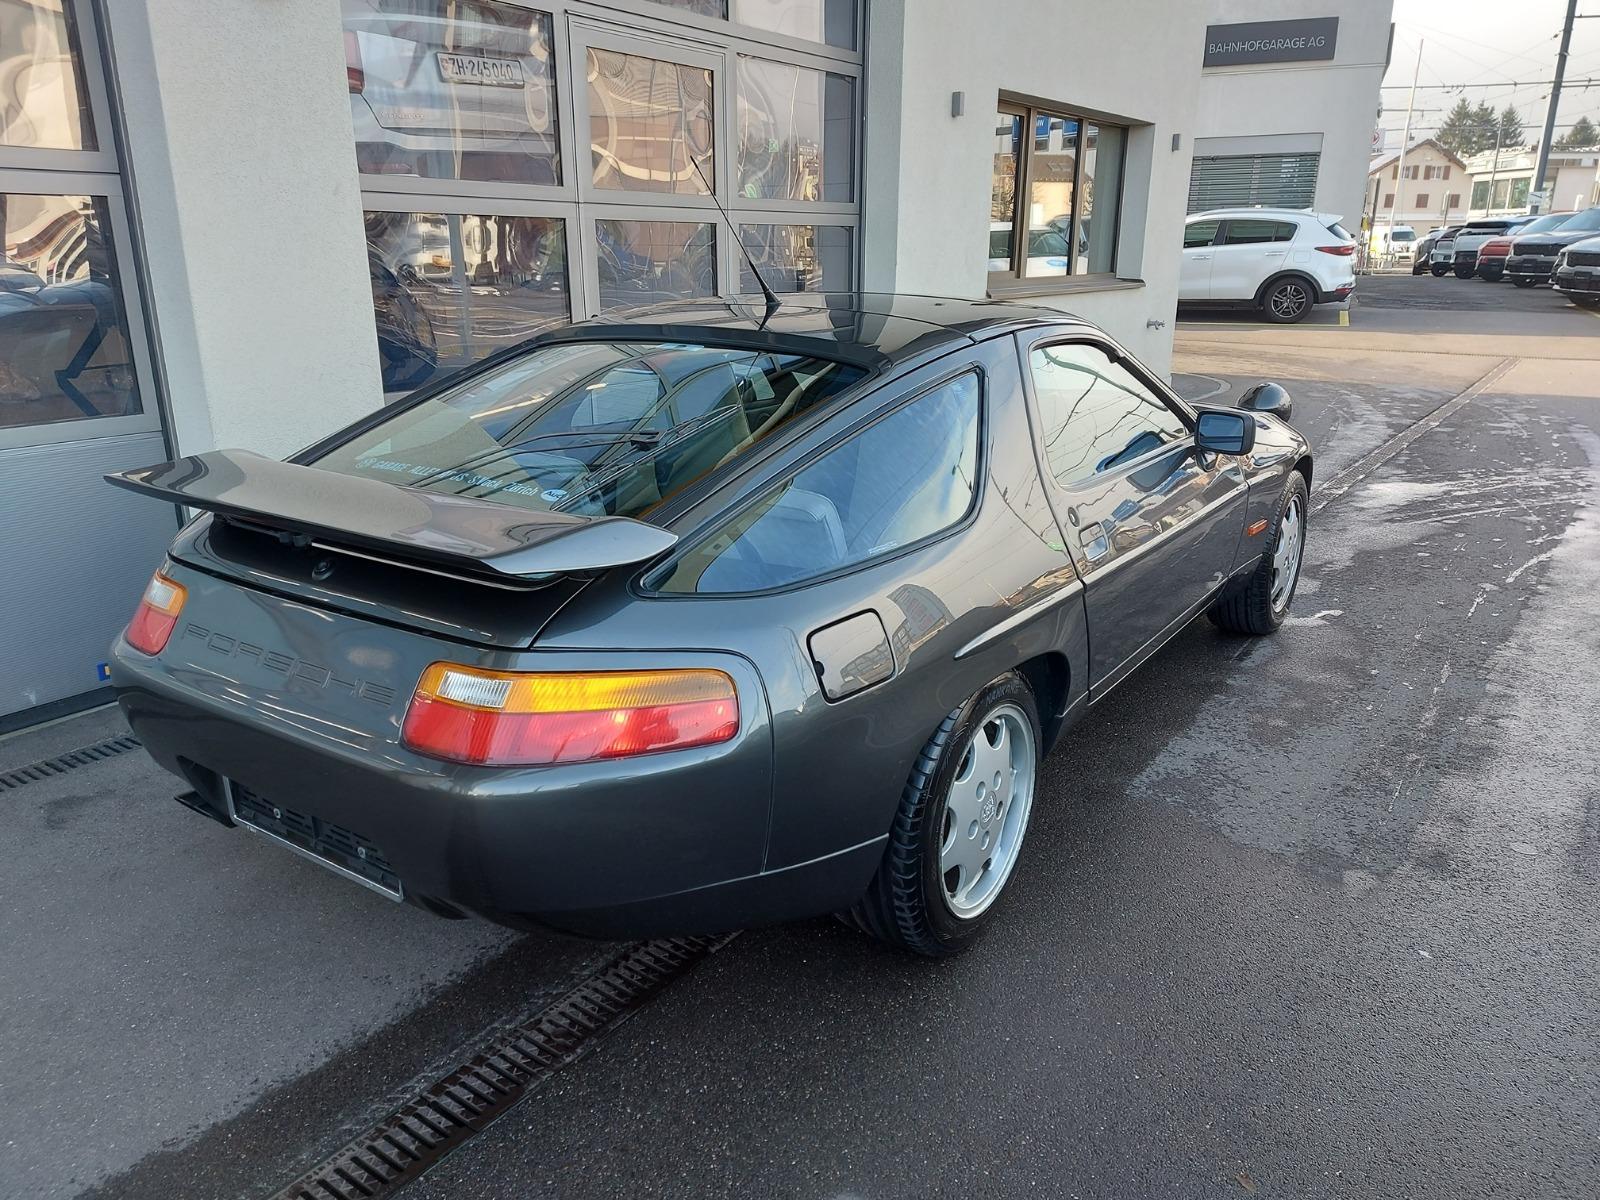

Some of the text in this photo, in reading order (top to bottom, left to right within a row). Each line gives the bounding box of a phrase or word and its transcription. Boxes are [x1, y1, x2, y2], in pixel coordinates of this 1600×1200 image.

[1208, 35, 1325, 54] BAHNHOFGARAGE AG
[181, 622, 396, 707] PORSCHE
